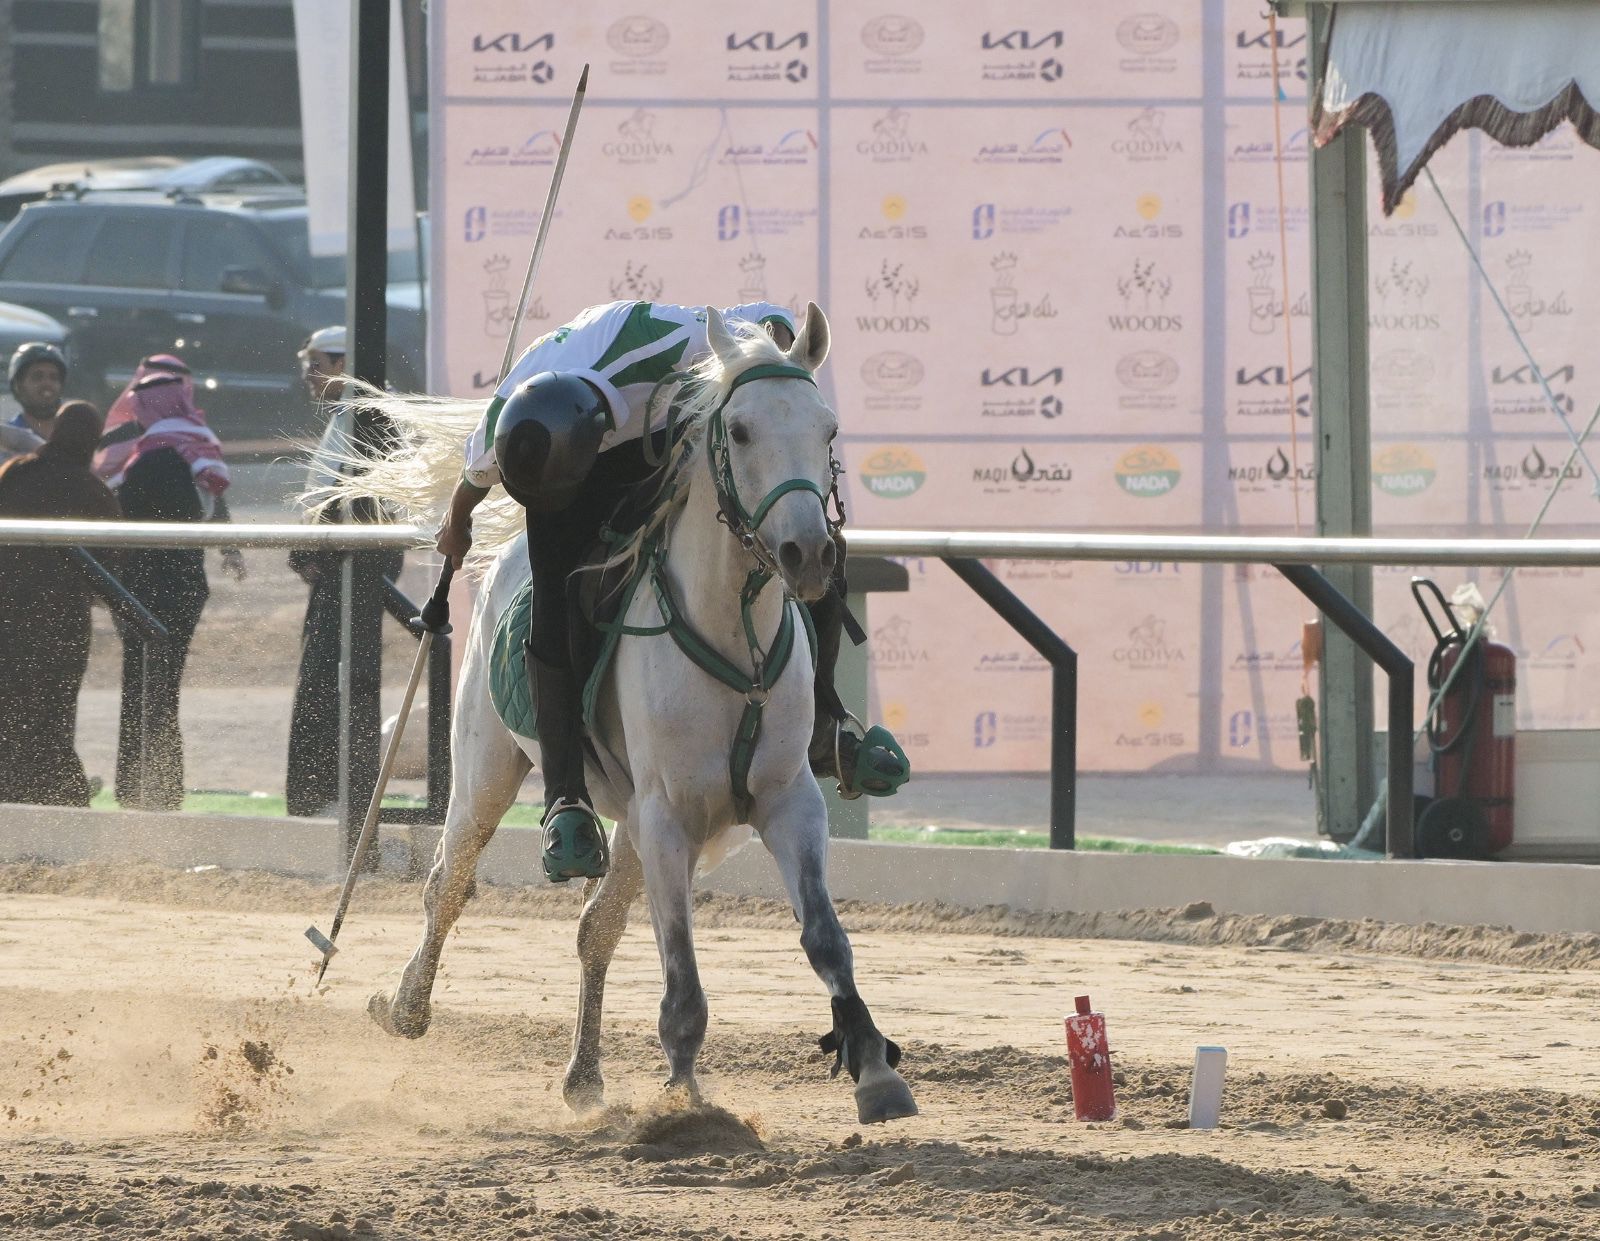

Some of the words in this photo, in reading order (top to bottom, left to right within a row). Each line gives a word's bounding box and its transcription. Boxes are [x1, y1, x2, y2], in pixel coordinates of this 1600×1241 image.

[473, 33, 554, 52] KIA
[727, 32, 808, 51] KIA
[981, 31, 1063, 50] KIA
[602, 143, 673, 156] GODIVA
[856, 141, 929, 155] GODIVA
[1111, 140, 1184, 153] GODIVA
[856, 317, 930, 333] WOODS
[1108, 315, 1183, 331] WOODS
[981, 367, 1063, 386] KIA
[1492, 365, 1574, 384] KIA
[973, 468, 1008, 483] NAQI
[1228, 467, 1263, 482] NAQI
[1381, 474, 1425, 489] NADA
[871, 476, 916, 492] NADA
[1126, 475, 1170, 491] NADA
[1113, 649, 1185, 662] GODIVA
